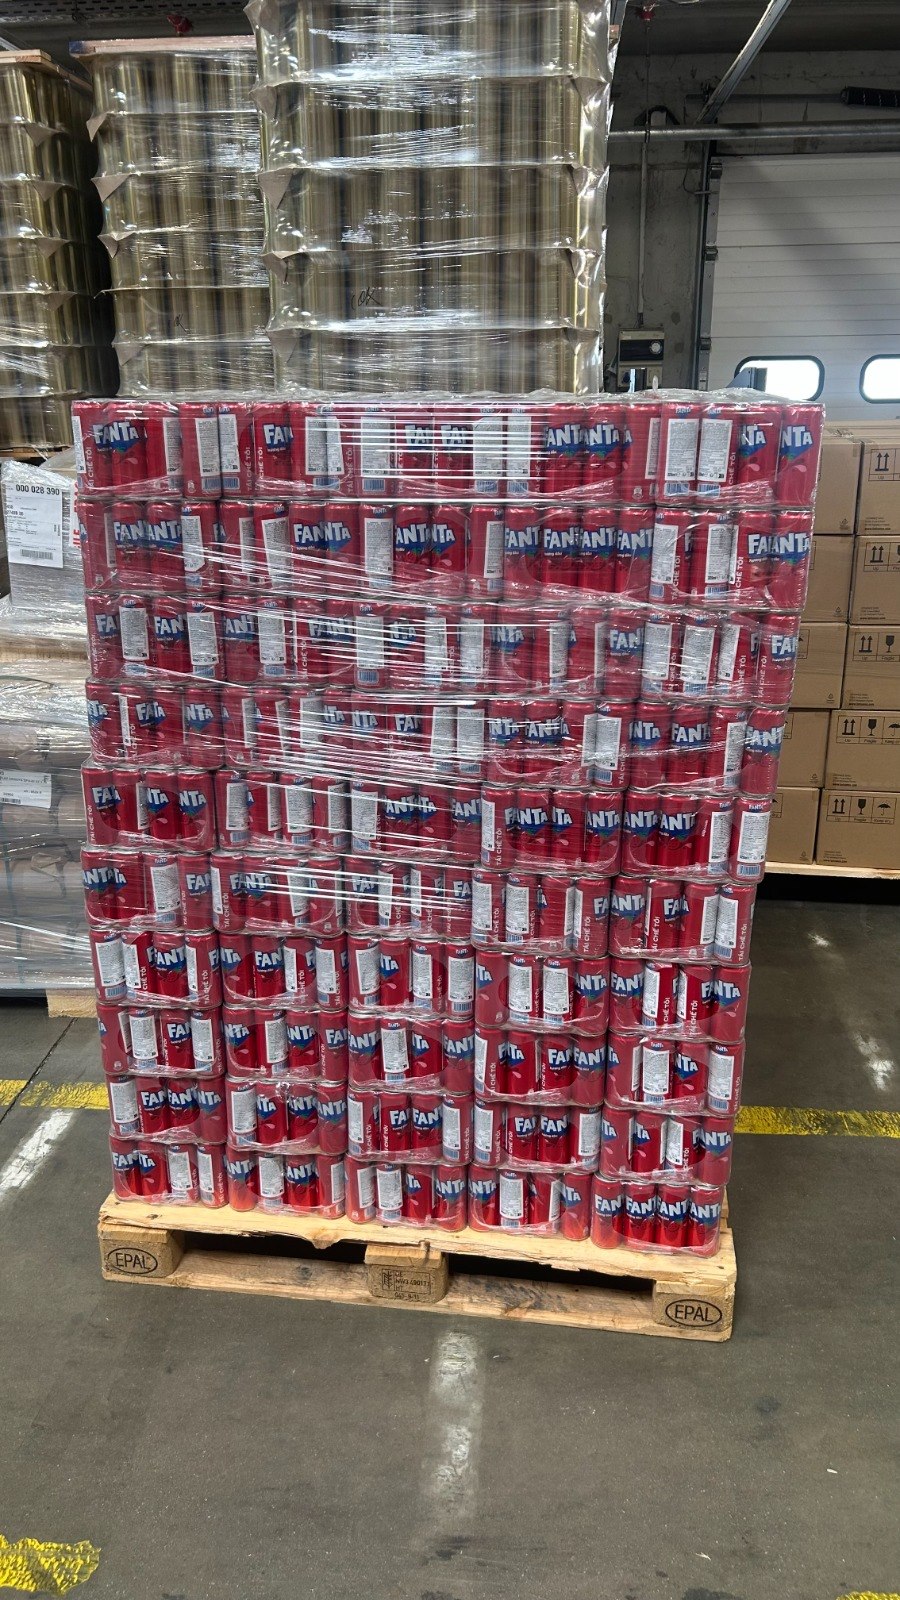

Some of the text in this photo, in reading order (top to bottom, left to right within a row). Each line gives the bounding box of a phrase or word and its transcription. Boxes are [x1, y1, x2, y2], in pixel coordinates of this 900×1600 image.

[783, 426, 813, 446] NTA
[16, 484, 29, 492] 000
[31, 486, 44, 494] 028
[46, 487, 60, 496] 390
[114, 521, 144, 541] FAN
[294, 522, 325, 543] FAN
[154, 616, 180, 635] FAN
[609, 629, 640, 651] FAN
[187, 703, 213, 721] NTA
[351, 710, 378, 728] NTA
[489, 718, 519, 736] NTA
[179, 790, 206, 807] NTA
[254, 951, 283, 967] FAN
[224, 1022, 249, 1038] NTA
[141, 1091, 166, 1106] FAN
[198, 1091, 221, 1106] NTA
[412, 1108, 441, 1125] FAN
[541, 1116, 568, 1132] FAN
[112, 1153, 137, 1167] FAN
[595, 1195, 621, 1211] FAN
[116, 1252, 150, 1270] EPAL
[674, 1304, 713, 1322] EPAL
